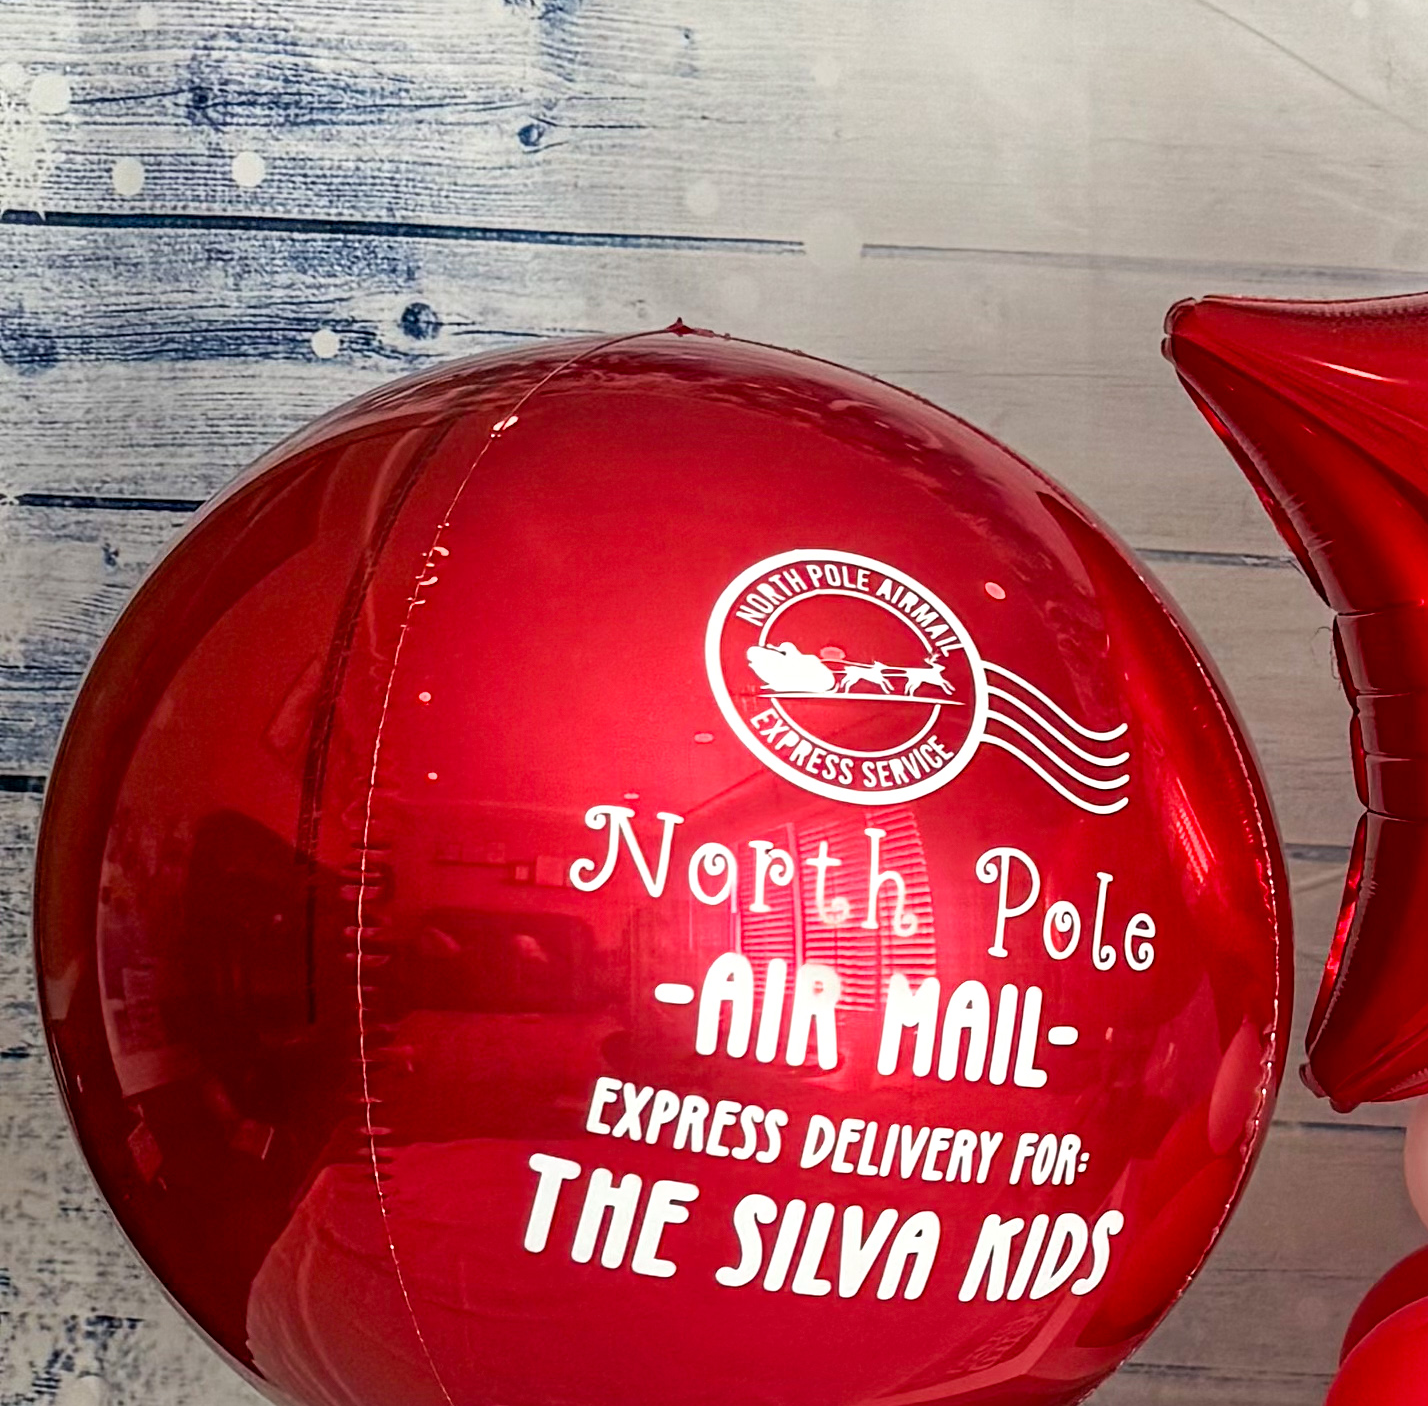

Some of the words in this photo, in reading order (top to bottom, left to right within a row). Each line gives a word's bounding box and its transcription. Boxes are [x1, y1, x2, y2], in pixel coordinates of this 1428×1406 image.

[736, 565, 803, 627] NORTH
[808, 565, 870, 594] POLE
[878, 577, 962, 657] AIRMAIL
[750, 708, 852, 786] EXPRESS
[863, 734, 954, 788] SERVICE
[569, 806, 917, 937] North
[976, 847, 1156, 972] Pole
[586, 1077, 789, 1163] EXPRESS
[801, 1117, 1006, 1185] DELIVERY
[1009, 1133, 1089, 1186] FOR:
[523, 1154, 699, 1278] THE
[715, 1195, 942, 1300] SILVA
[958, 1211, 1124, 1302] KIDS
